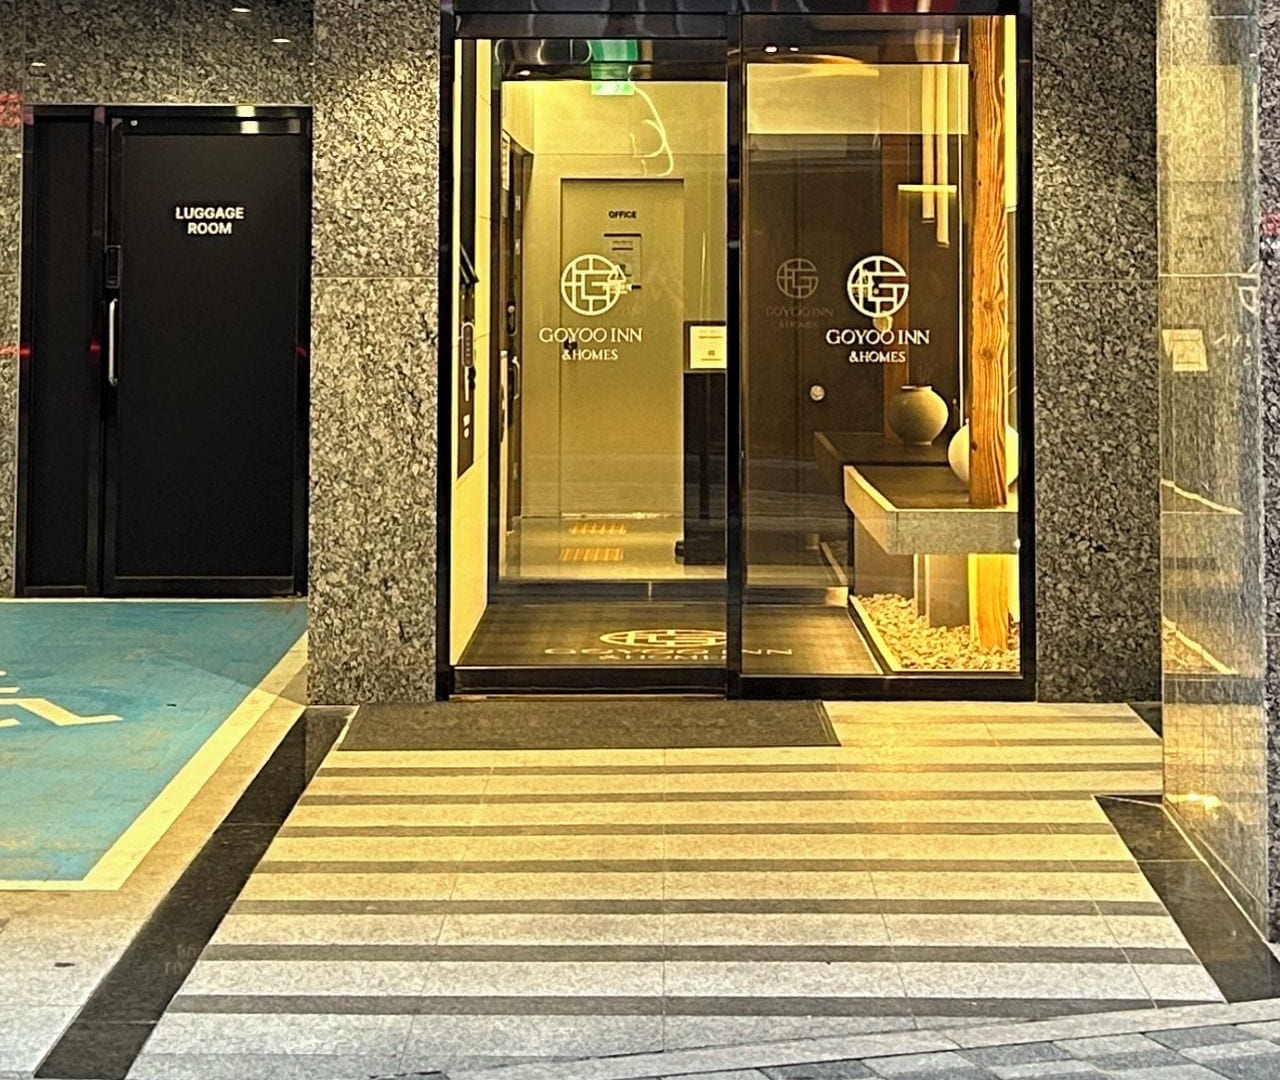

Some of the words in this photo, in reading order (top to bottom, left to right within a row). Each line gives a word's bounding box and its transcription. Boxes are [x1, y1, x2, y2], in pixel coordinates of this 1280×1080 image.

[175, 206, 245, 220] LUGGAGE
[608, 210, 637, 219] OFFICE
[187, 221, 233, 235] ROOM
[539, 327, 607, 343] GOYOO
[611, 327, 643, 343] INN
[825, 329, 895, 345] GOYOO
[898, 329, 930, 345] INN
